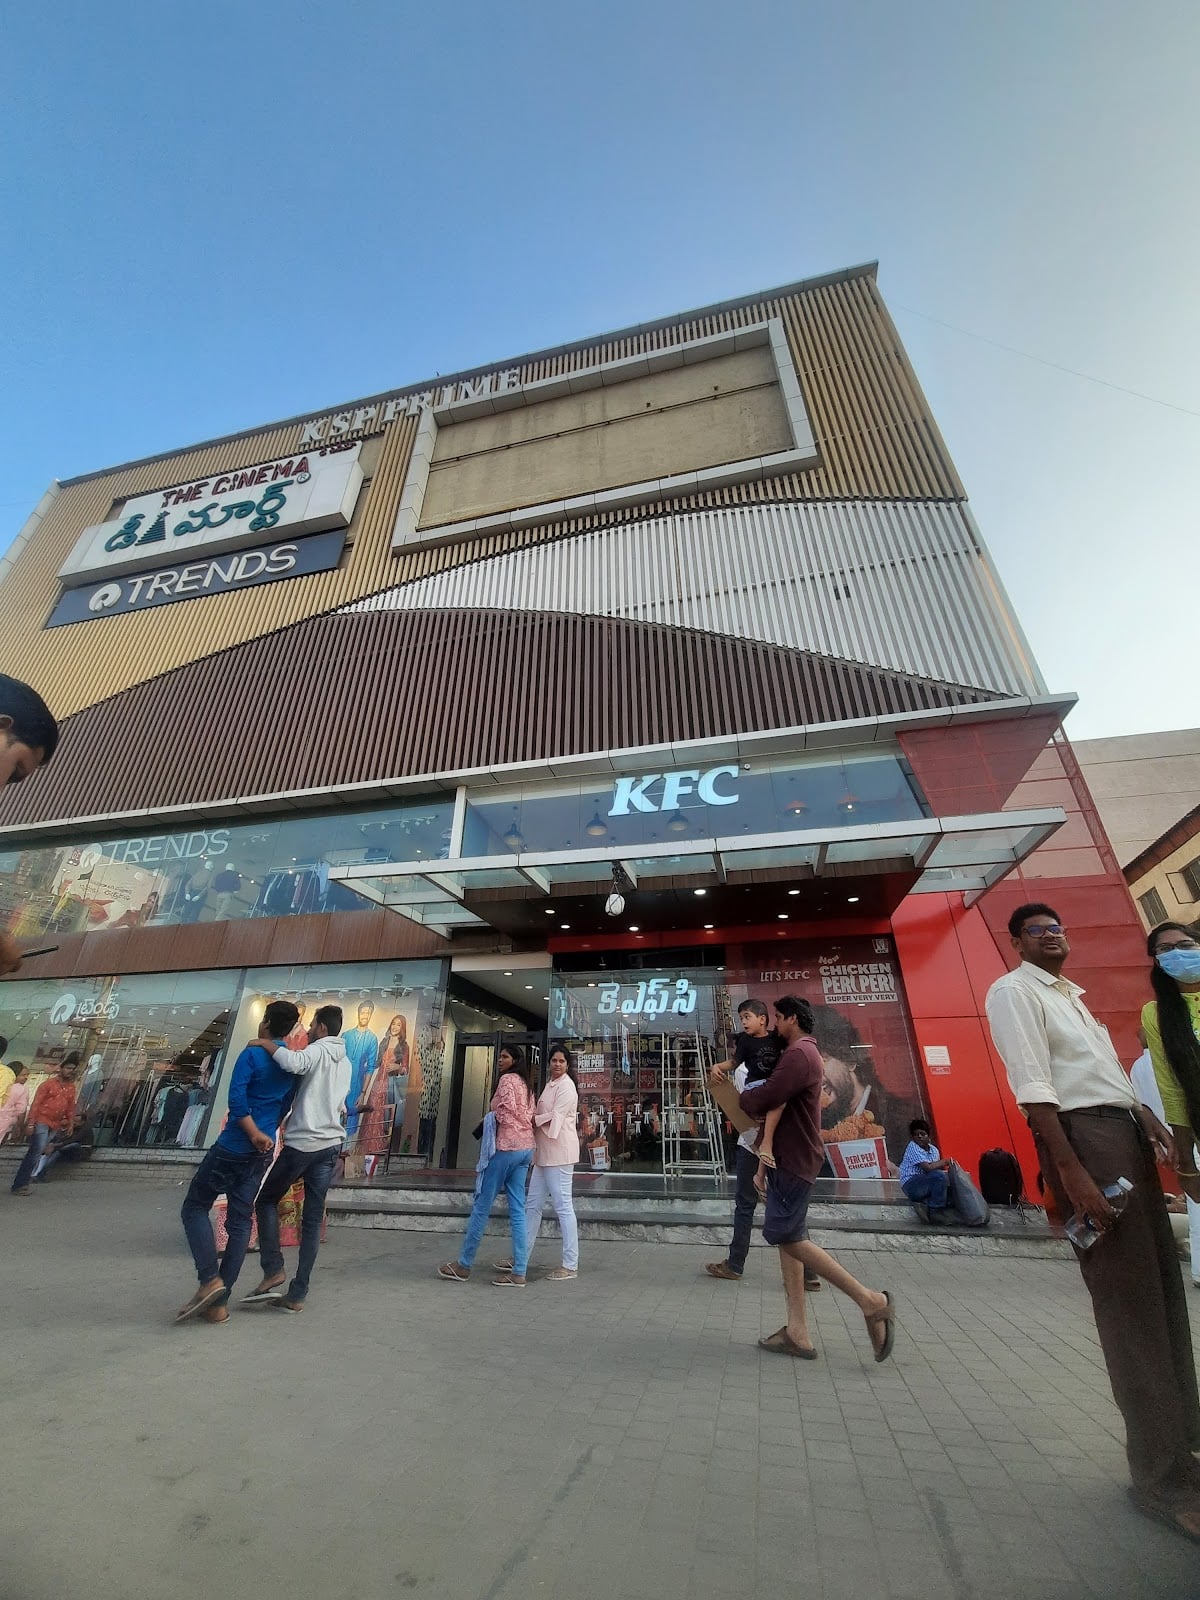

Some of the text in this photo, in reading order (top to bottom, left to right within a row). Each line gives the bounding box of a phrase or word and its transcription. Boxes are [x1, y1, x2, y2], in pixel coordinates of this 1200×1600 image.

[298, 368, 522, 445] KSP PRIME
[161, 456, 310, 508] THE CINEMA
[127, 545, 298, 605] TRENDS
[607, 765, 740, 818] KFC
[103, 829, 231, 866] TRENDS
[760, 970, 811, 982] LET'S KFC
[819, 963, 892, 976] CHICKEN
[821, 975, 859, 994] PERI
[826, 992, 897, 1002] SUPER VERY VERY
